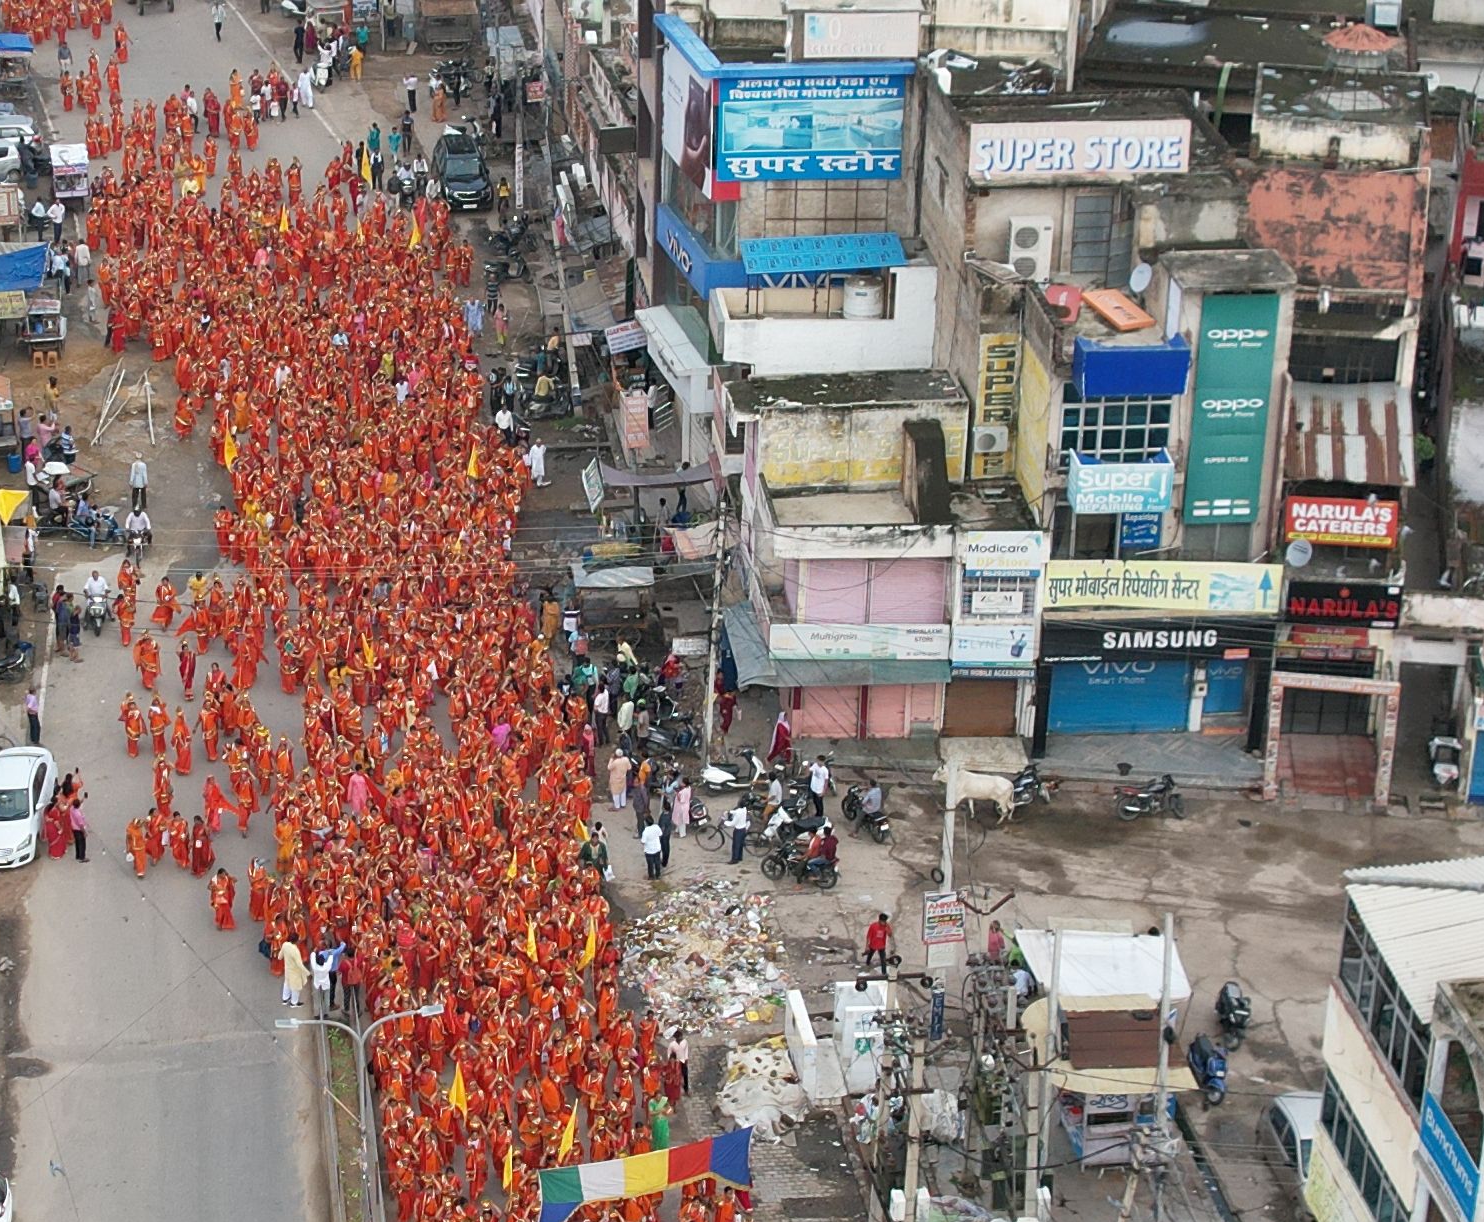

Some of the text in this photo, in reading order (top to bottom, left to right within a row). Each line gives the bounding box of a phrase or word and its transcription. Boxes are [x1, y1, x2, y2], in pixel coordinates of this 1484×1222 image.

[974, 134, 1182, 172] SUPER STORE
[725, 151, 900, 178] सुपर स्टोर
[1078, 468, 1154, 490] Super
[1077, 493, 1144, 504] Mobile
[1077, 503, 1143, 512] REPAIRING
[1291, 503, 1392, 522] NARULA'S
[1294, 518, 1387, 536] CATERERS
[968, 544, 1029, 553] Modicare
[1049, 577, 1072, 604] सुपर
[1075, 568, 1121, 600] मोबाईल
[1290, 597, 1398, 619] NARULA'S
[811, 632, 858, 642] Multigrain
[1103, 629, 1218, 649] SAMSUNG
